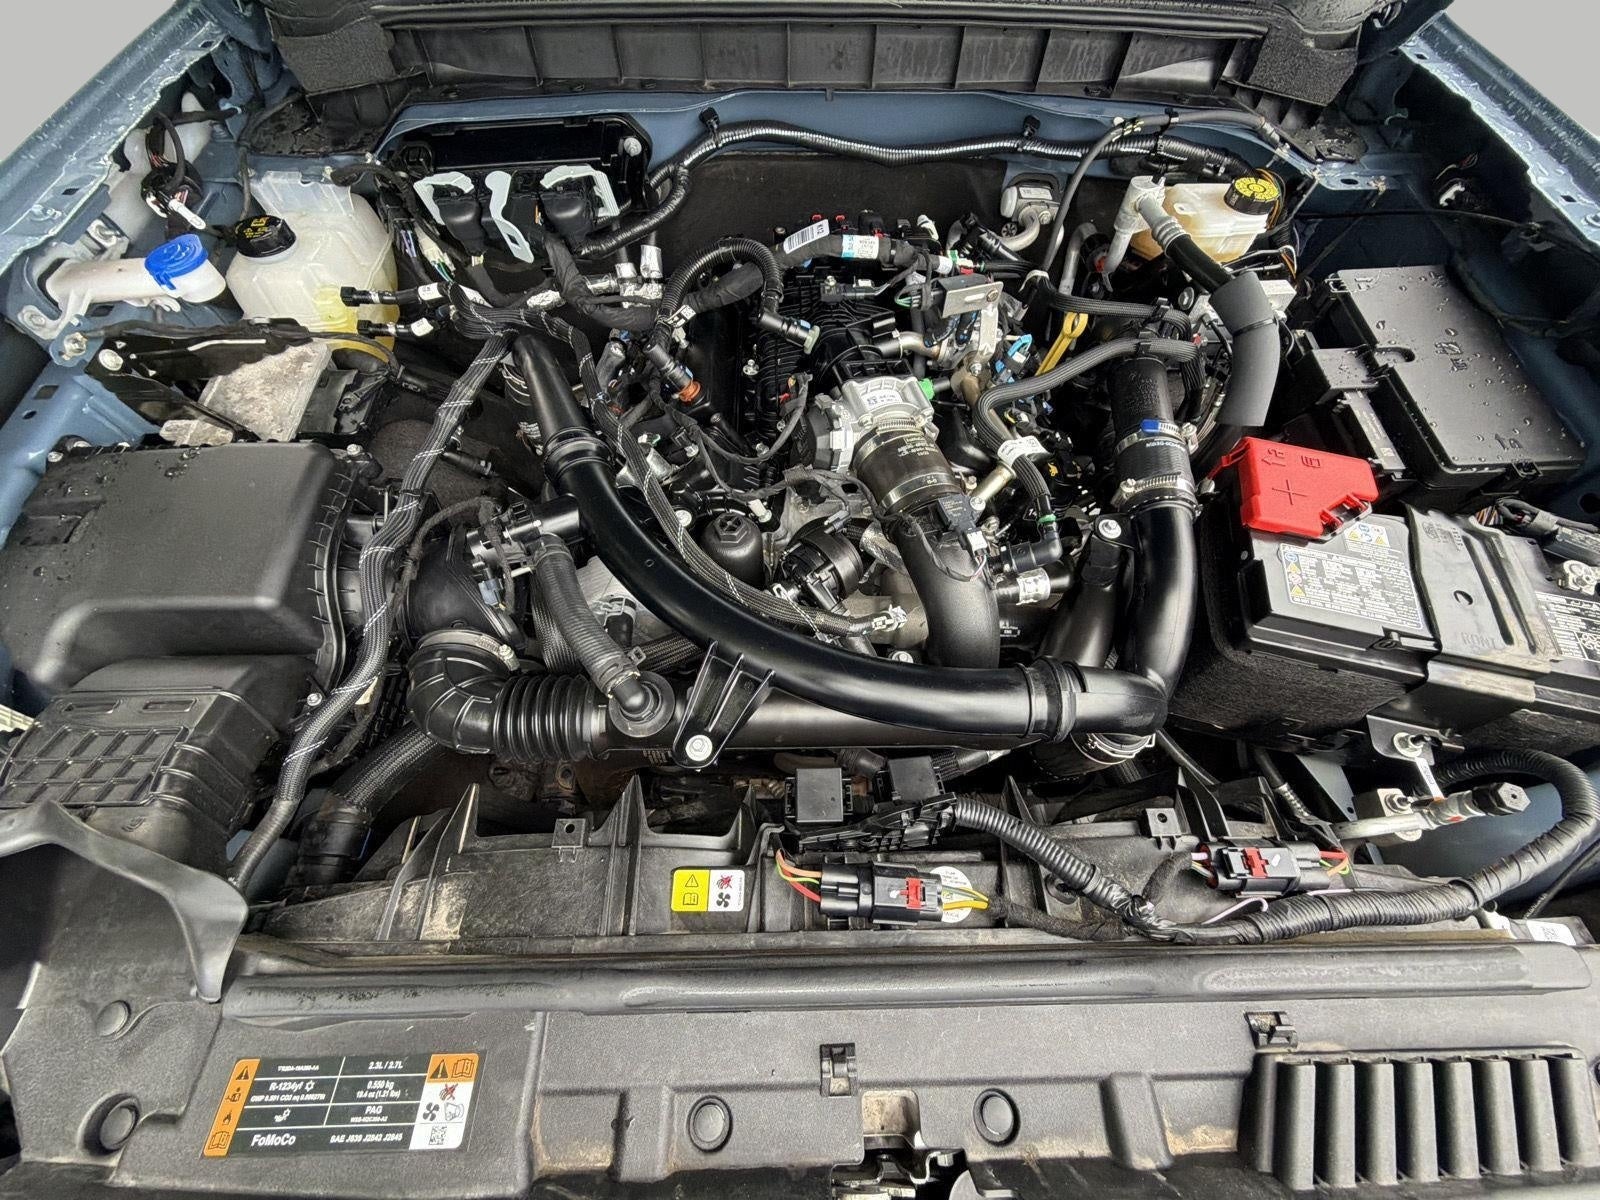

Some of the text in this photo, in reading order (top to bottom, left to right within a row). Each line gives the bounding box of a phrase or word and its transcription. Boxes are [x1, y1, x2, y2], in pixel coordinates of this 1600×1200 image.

[368, 1061, 384, 1070] 2.3L
[388, 1060, 403, 1069] 2.7L
[269, 1082, 304, 1092] R-1234yf
[367, 1080, 395, 1091] 0.550 kg
[365, 1105, 383, 1114] PAG
[250, 1133, 297, 1146] FoMoCo
[330, 1134, 345, 1143] SAE
